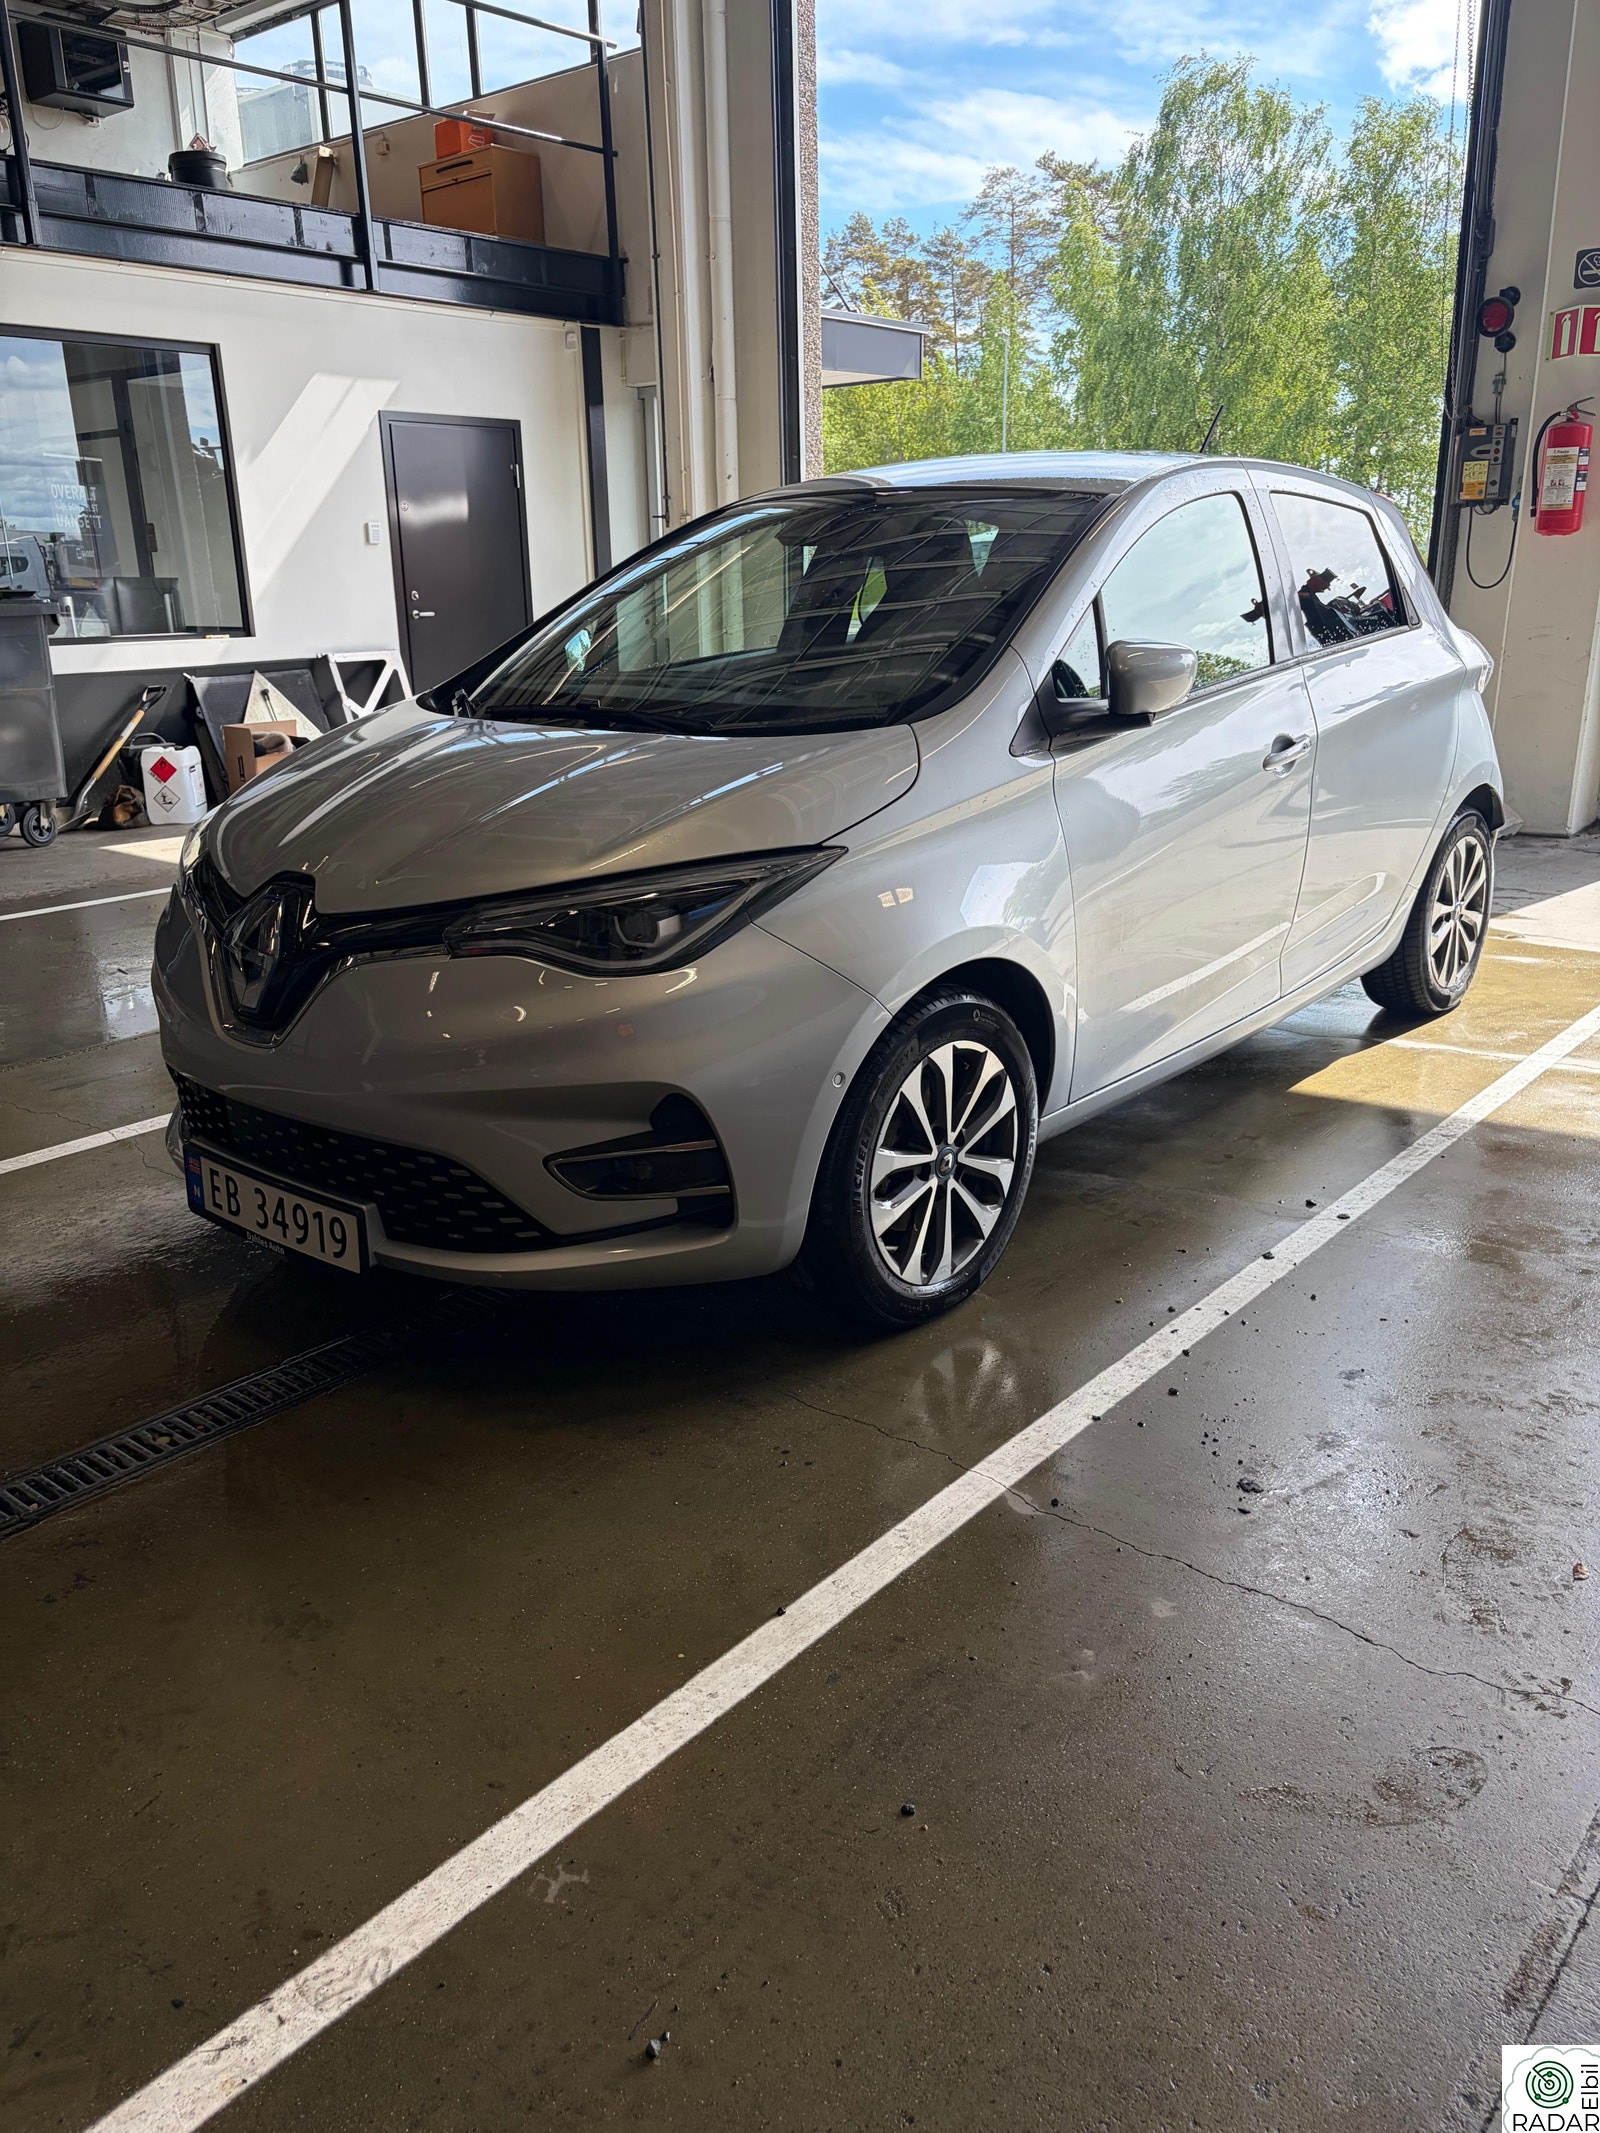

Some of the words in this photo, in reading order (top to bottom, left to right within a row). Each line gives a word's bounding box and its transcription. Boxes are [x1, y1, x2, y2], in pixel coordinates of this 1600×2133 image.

[193, 1184, 201, 1198] N
[209, 1167, 241, 1217] EB
[254, 1187, 347, 1259] 34919
[246, 1231, 268, 1248] Dahles
[268, 1240, 285, 1255] Auto
